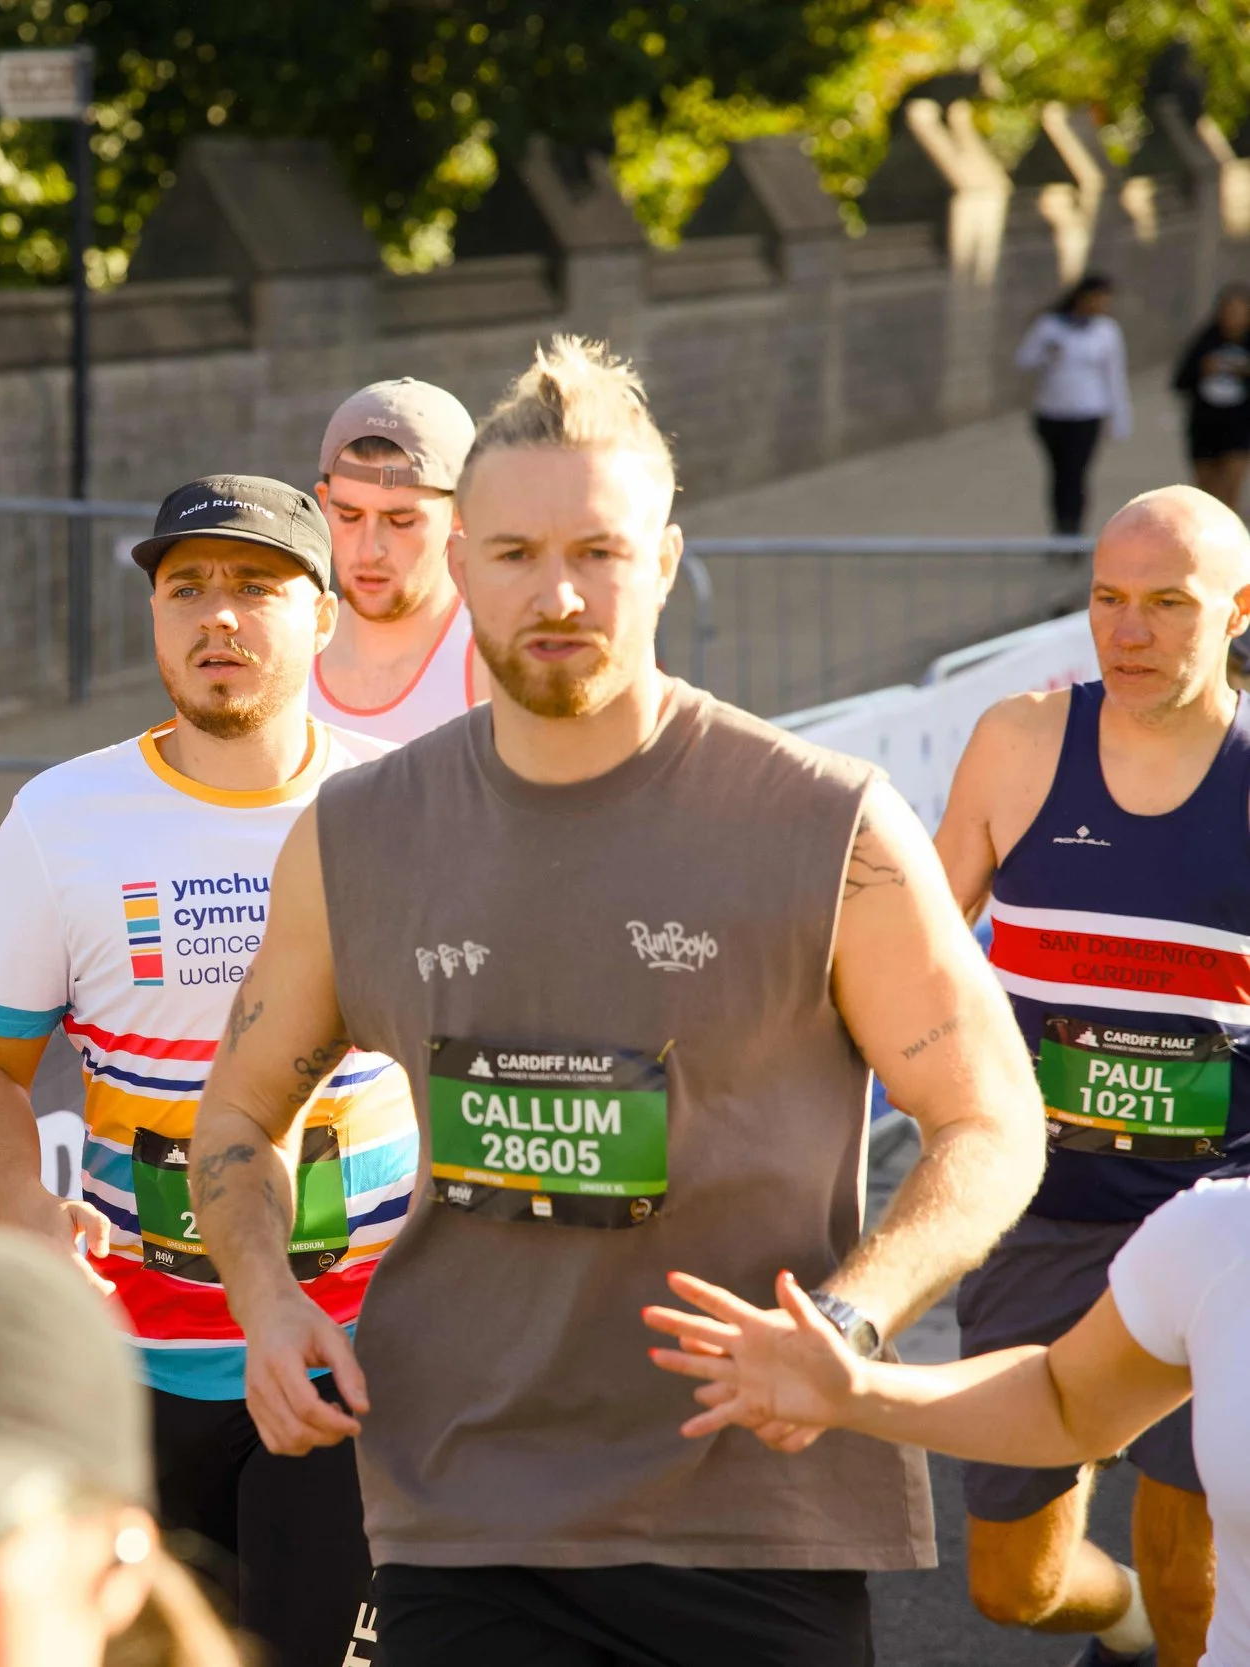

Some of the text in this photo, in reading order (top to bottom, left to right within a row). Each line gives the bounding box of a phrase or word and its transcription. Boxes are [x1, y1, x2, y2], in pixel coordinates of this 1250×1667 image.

[366, 416, 397, 429] POLO
[179, 499, 276, 520] Acid Running
[174, 905, 265, 930] cymru
[176, 934, 261, 956] cance
[1039, 932, 1217, 970] SAN DOMENICO
[179, 961, 245, 985] wale
[1071, 962, 1175, 989] CARDIFF
[1103, 1030, 1196, 1049] CARDIFF HALF
[497, 1053, 613, 1072] CARDIFF HALF
[1088, 1058, 1172, 1093] PAUL
[461, 1090, 622, 1135] CALLUM
[1079, 1087, 1175, 1123] 10211
[481, 1132, 601, 1176] 28605
[155, 1250, 174, 1264] R4W
[166, 1240, 203, 1253] GREEN PEN
[292, 1241, 325, 1251] MEDIUM
